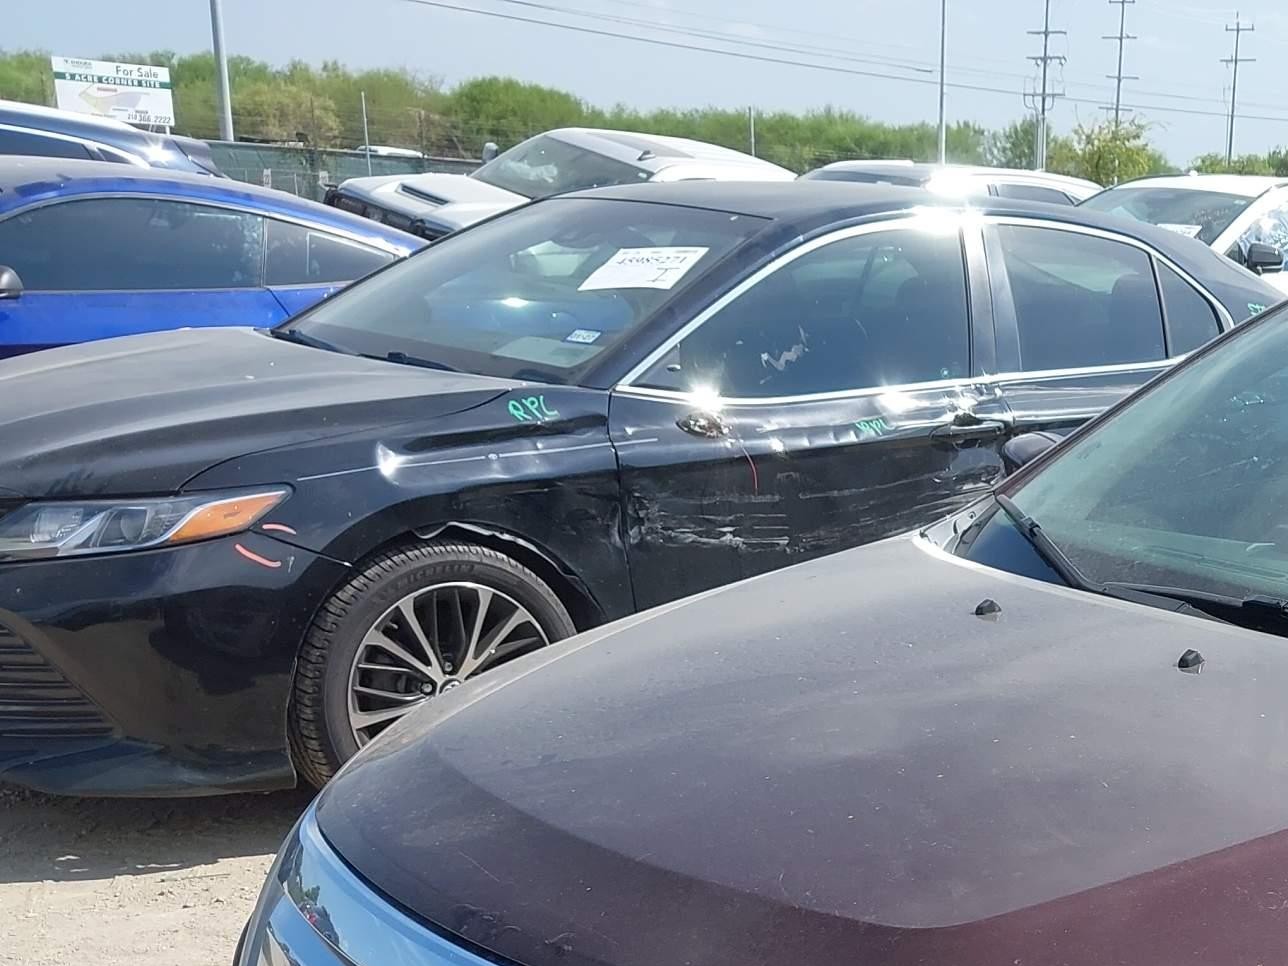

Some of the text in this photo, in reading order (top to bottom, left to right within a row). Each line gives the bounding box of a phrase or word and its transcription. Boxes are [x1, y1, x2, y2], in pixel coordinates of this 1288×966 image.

[115, 66, 159, 79] For Sale
[75, 73, 99, 83] ACRE
[102, 76, 139, 87] CORNER
[141, 79, 161, 89] SITE
